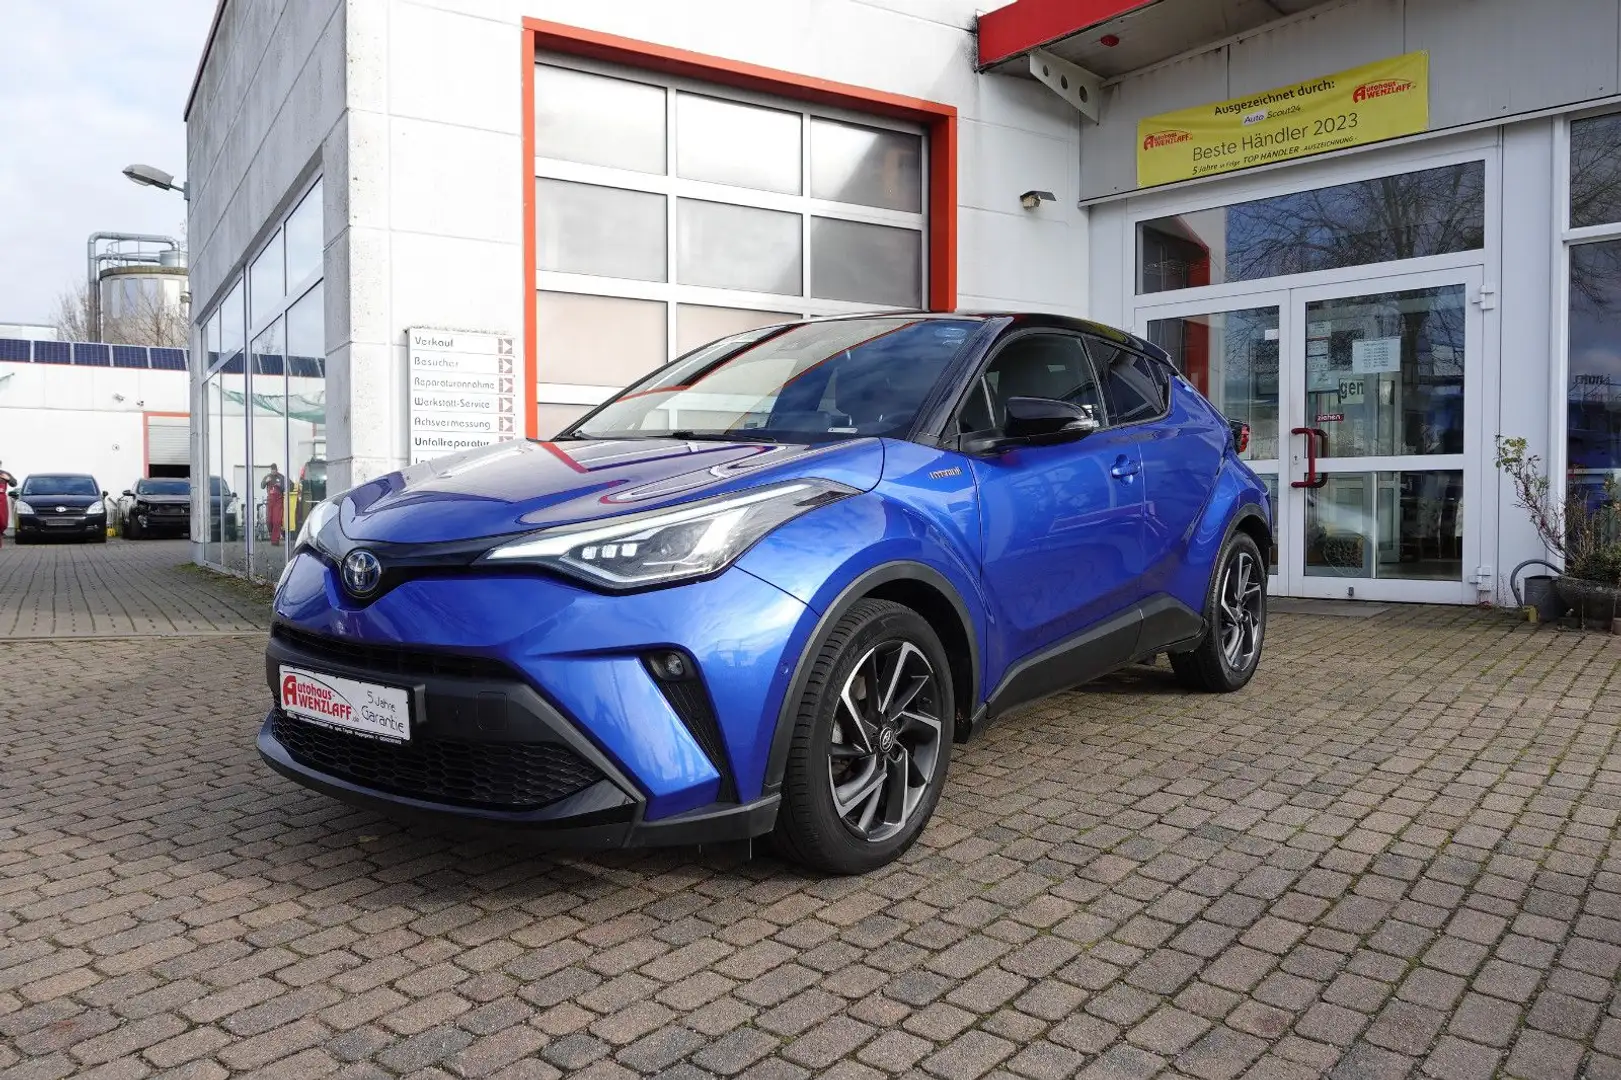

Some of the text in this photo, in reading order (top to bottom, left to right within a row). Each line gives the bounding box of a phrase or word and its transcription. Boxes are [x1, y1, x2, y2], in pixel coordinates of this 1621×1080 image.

[1214, 80, 1335, 115] Ausgezeichnet durch:
[1367, 82, 1412, 99] WENZLAFF
[1192, 112, 1358, 161] Beste Händler 2023
[1192, 166, 1198, 175] 5
[1243, 154, 1259, 164] TOP
[415, 336, 454, 347] Verkauf
[414, 356, 459, 368] Besucher
[414, 377, 495, 389] Reparaturannahme
[414, 397, 491, 409] Werkstatt-Service
[414, 417, 491, 430] Achsvermessung
[297, 693, 352, 721] WENZLAFF
[366, 690, 397, 713] 5 Jahre
[361, 705, 405, 734] Garantie
